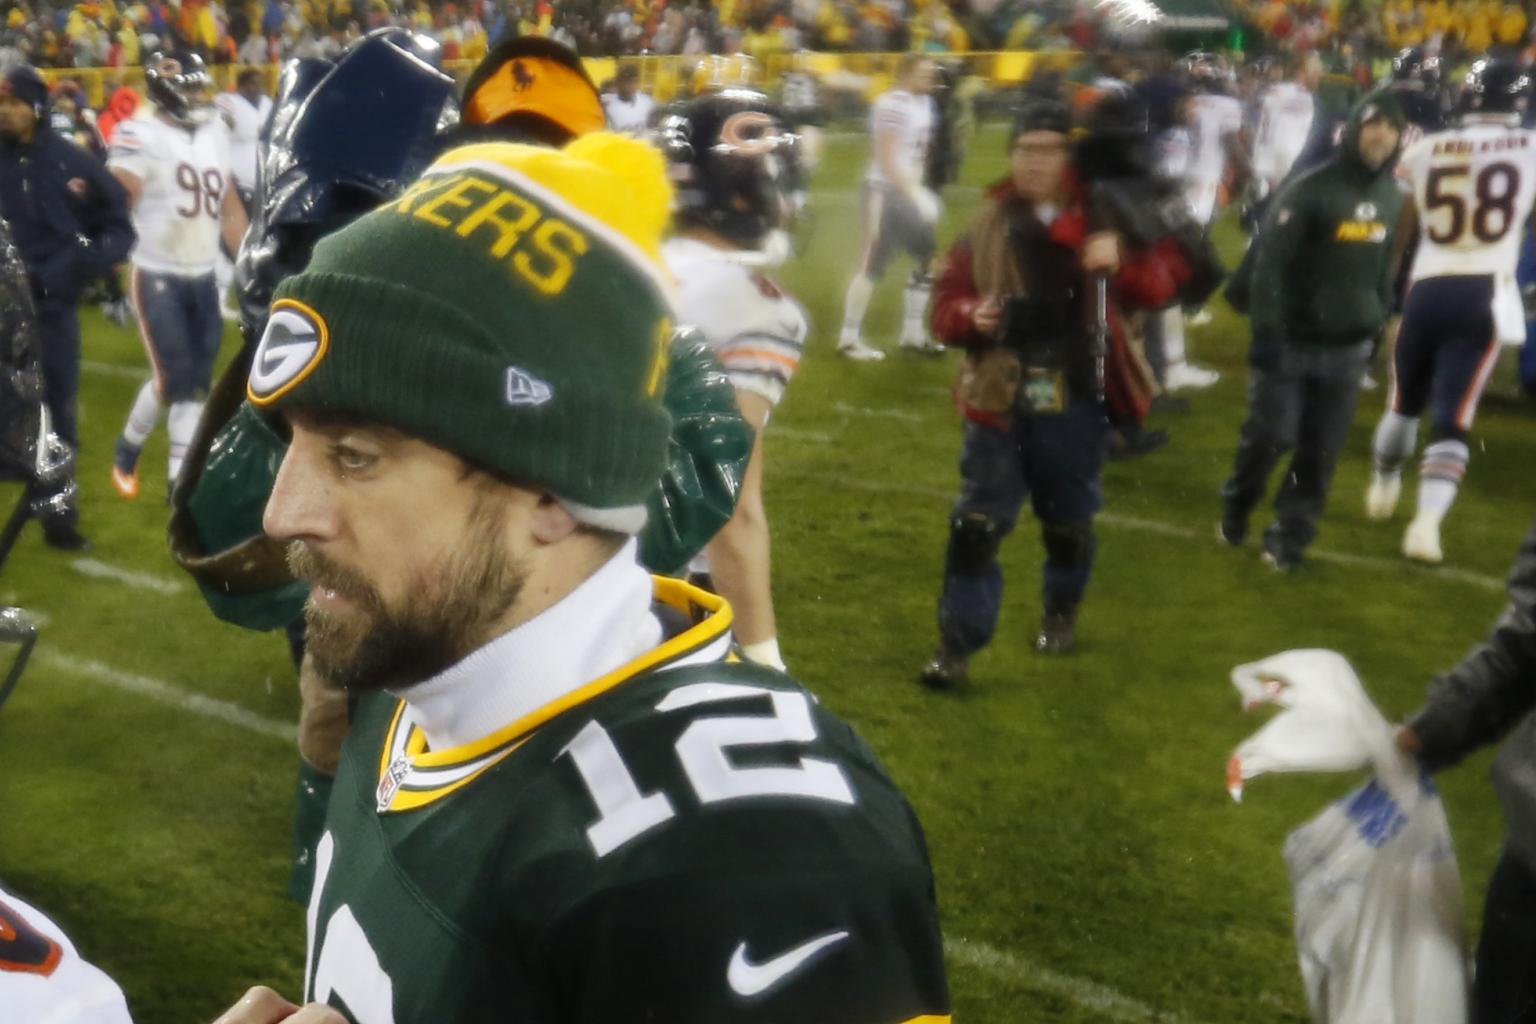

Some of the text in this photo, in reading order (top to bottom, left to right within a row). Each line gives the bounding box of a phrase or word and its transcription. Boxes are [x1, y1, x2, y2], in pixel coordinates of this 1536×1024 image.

[177, 163, 224, 219] 98
[1425, 162, 1521, 244] 58
[552, 682, 856, 858] 12
